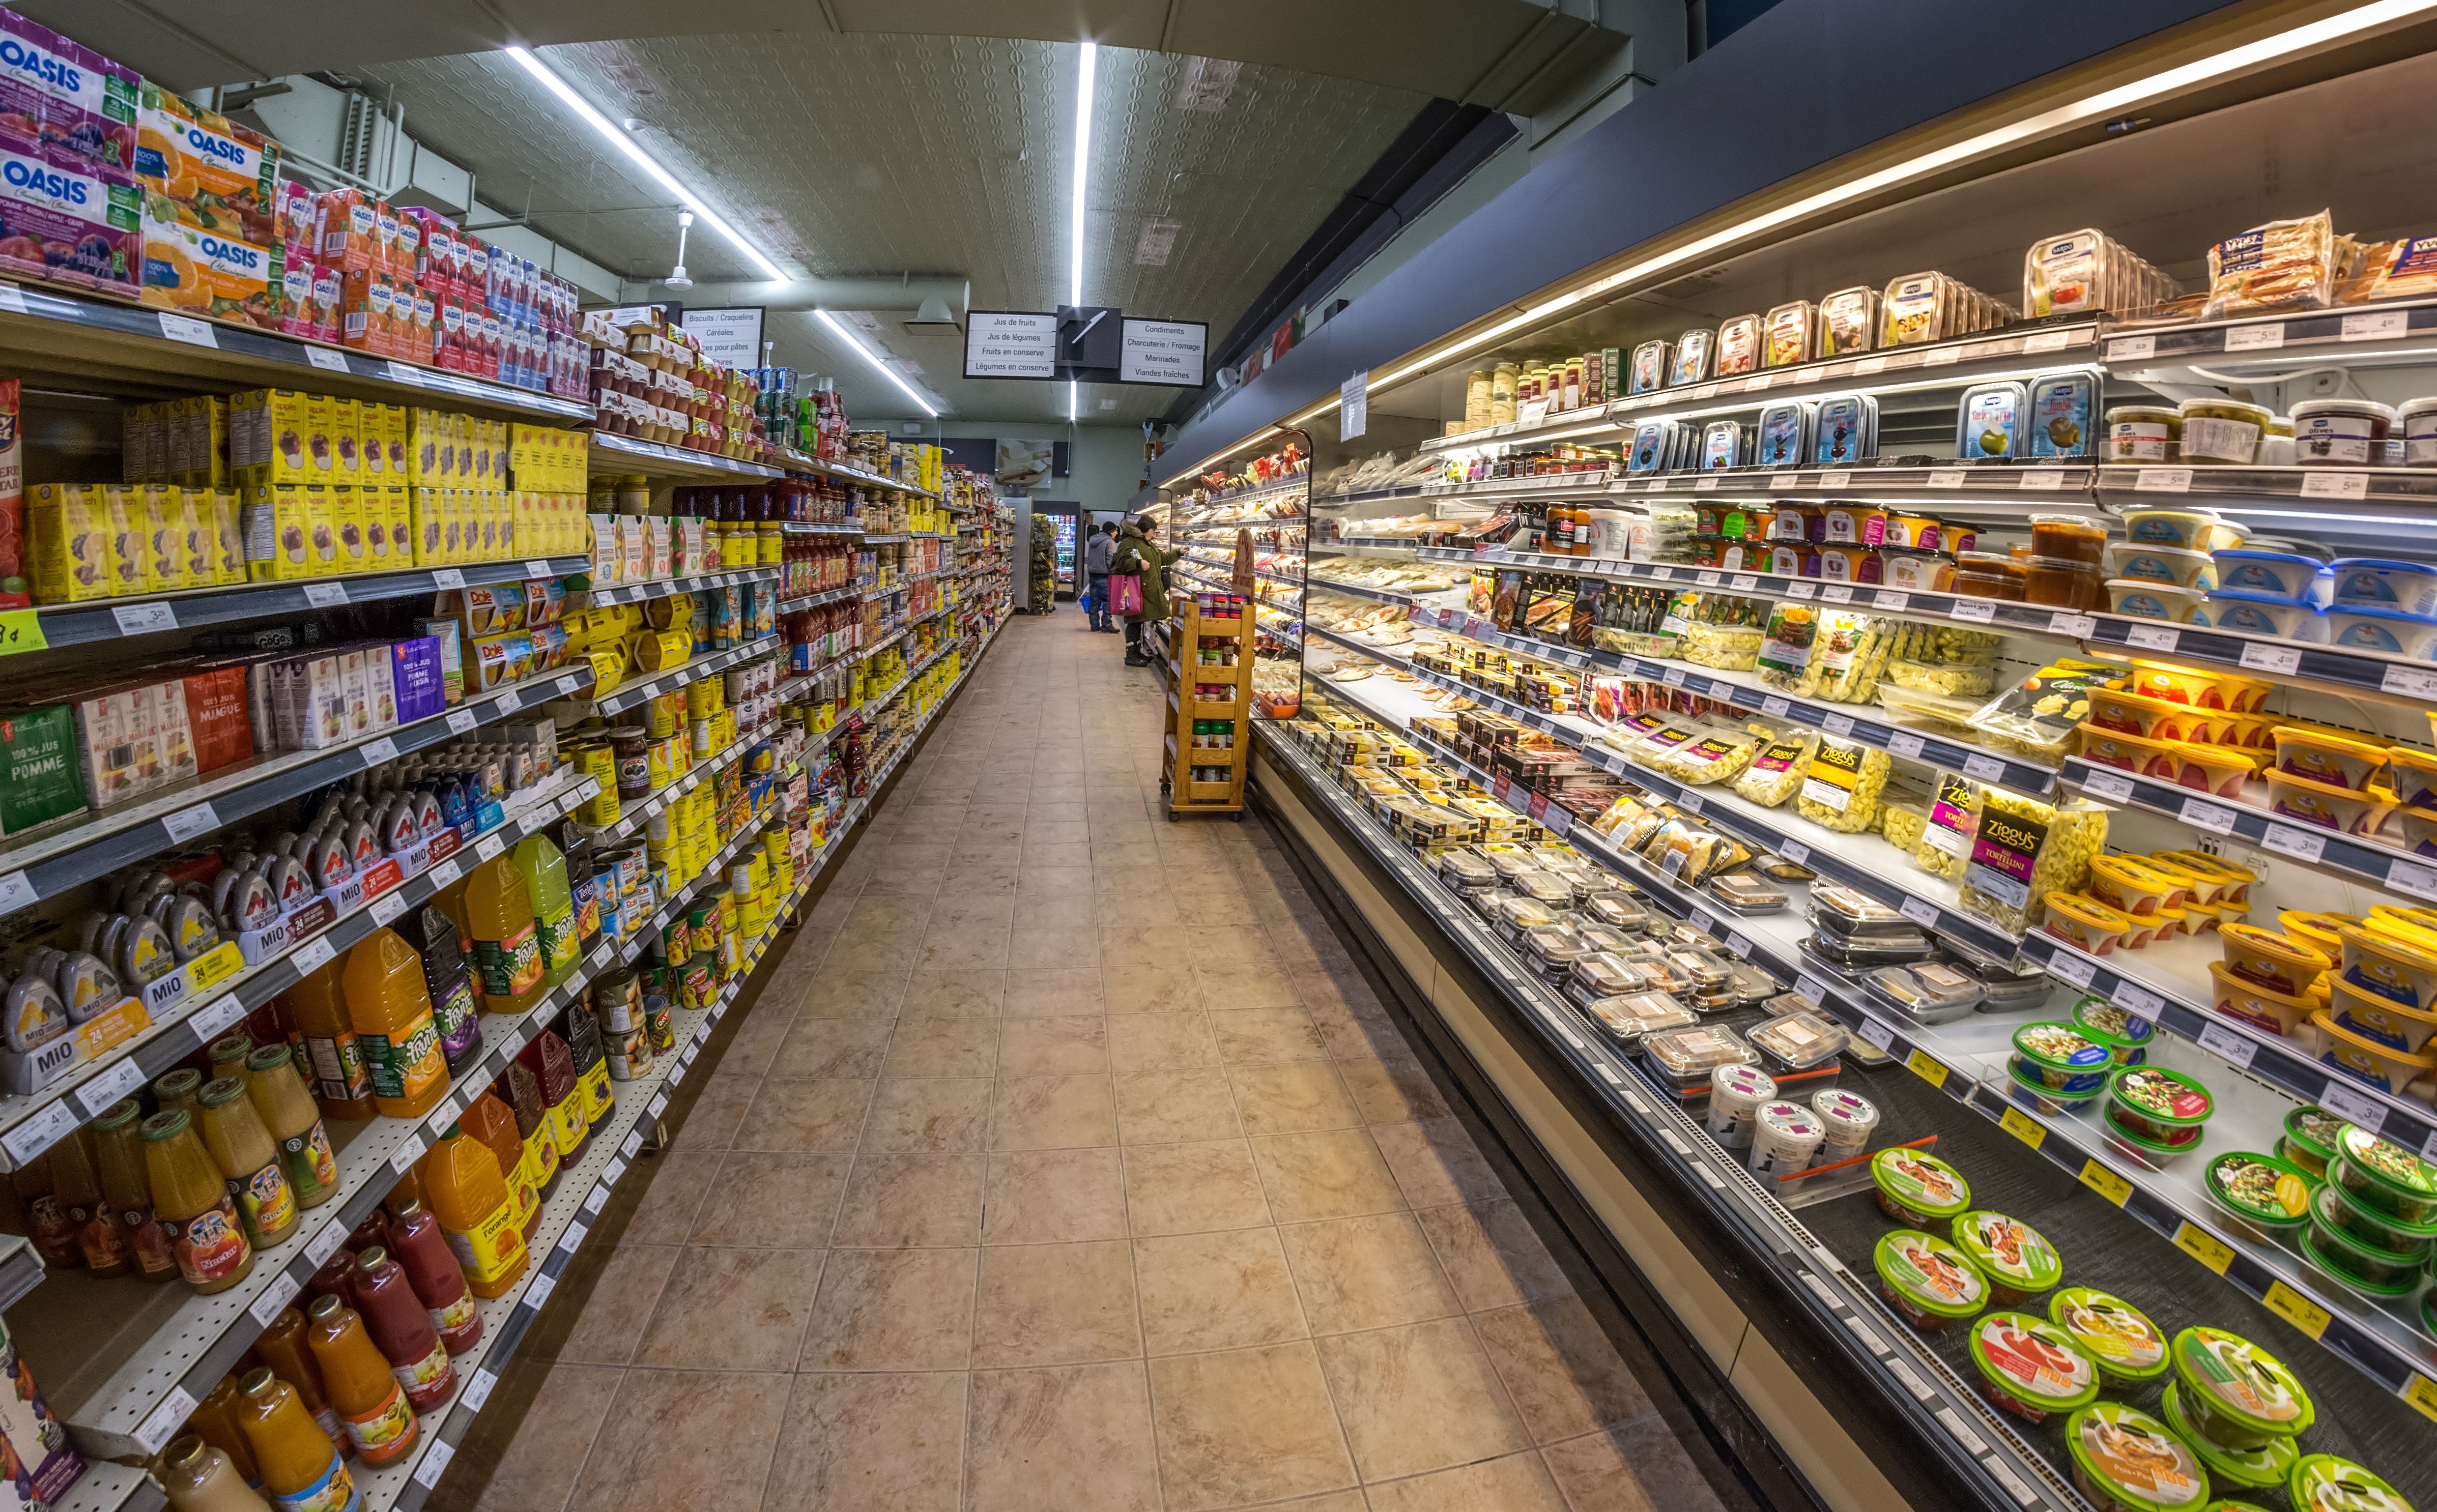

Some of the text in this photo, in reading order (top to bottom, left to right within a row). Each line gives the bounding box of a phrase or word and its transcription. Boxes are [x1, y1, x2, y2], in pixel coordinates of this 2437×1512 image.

[0, 41, 80, 92] OASIS
[188, 129, 245, 165] OASIS
[4, 161, 87, 204] OASIS
[352, 208, 372, 222] OASIS
[400, 227, 418, 241] OASIS
[202, 238, 259, 268] OASIS
[2052, 244, 2073, 254] SARDO
[370, 286, 391, 299] OASIS
[394, 294, 411, 307] OASIS
[689, 314, 714, 322] Biscuits
[720, 313, 754, 322] Craquelins
[1145, 326, 1184, 335] Condiments
[1013, 334, 1041, 342] légumes
[731, 342, 749, 352] pâtes
[1127, 339, 1165, 348] Charcuterie
[1172, 342, 1200, 351] Fromage
[1145, 355, 1180, 363] Marinades
[976, 363, 1006, 371] Légumes
[1135, 368, 1189, 379] Viandes fraîches
[2054, 387, 2072, 395] SARDO
[470, 591, 492, 602] Dole
[531, 585, 545, 597] Dole
[532, 634, 546, 645] Dole
[482, 644, 504, 657] Dole
[41, 741, 59, 752] JUS
[1702, 741, 1730, 754] Ziggy's
[1769, 748, 1798, 761] Ziggy's
[1820, 746, 1856, 765] Ziggy's
[12, 754, 65, 781] POMME
[1987, 819, 2039, 851] Ziggy's
[410, 849, 427, 866] MiO
[1985, 848, 2025, 871] TORTELLINI
[368, 878, 376, 888] 24
[341, 883, 360, 904] MiO
[579, 886, 594, 902] Tetley
[626, 899, 637, 907] Dole
[295, 918, 304, 930] 24
[295, 920, 304, 931] 24
[261, 926, 284, 949] MiO
[195, 967, 206, 982] 24
[152, 977, 182, 1003] MiO
[24, 1029, 45, 1041] MiO
[90, 1029, 103, 1045] 24
[37, 1042, 73, 1072] MiO
[261, 1200, 290, 1223] Nectar
[483, 1209, 511, 1237] l'orange
[201, 1245, 237, 1269] Nectar
